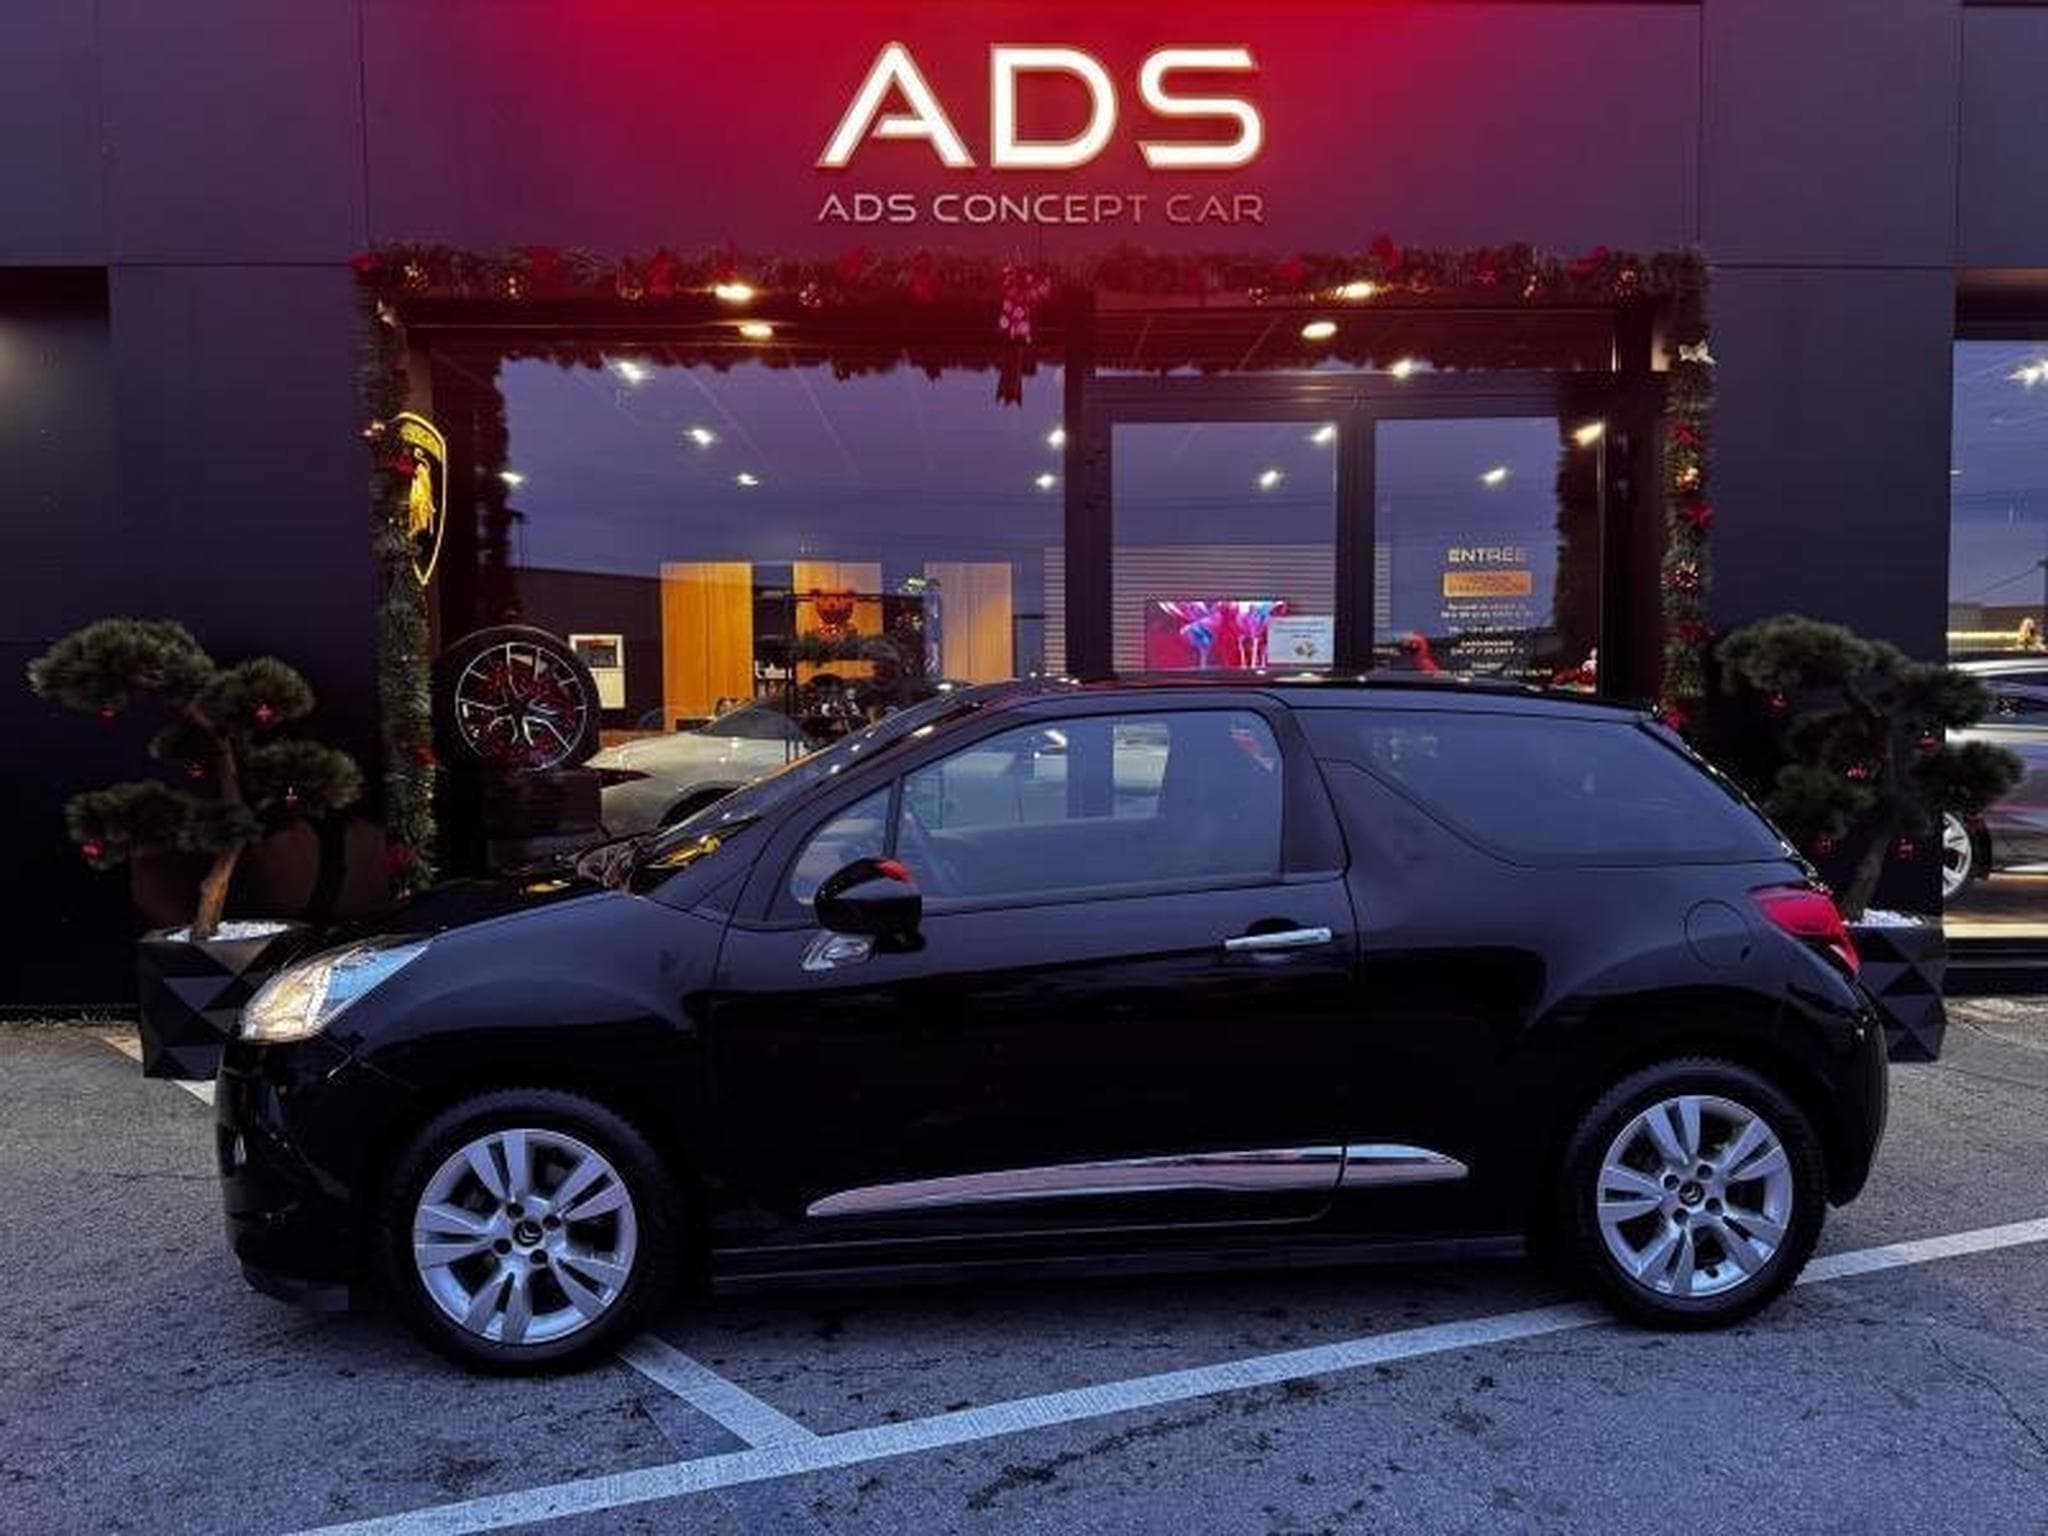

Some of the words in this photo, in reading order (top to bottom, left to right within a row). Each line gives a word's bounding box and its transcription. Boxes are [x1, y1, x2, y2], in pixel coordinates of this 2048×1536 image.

[817, 41, 1265, 169] ADS
[818, 194, 916, 224] ADS
[932, 194, 1148, 224] CONCEPT
[1165, 194, 1265, 224] CAR
